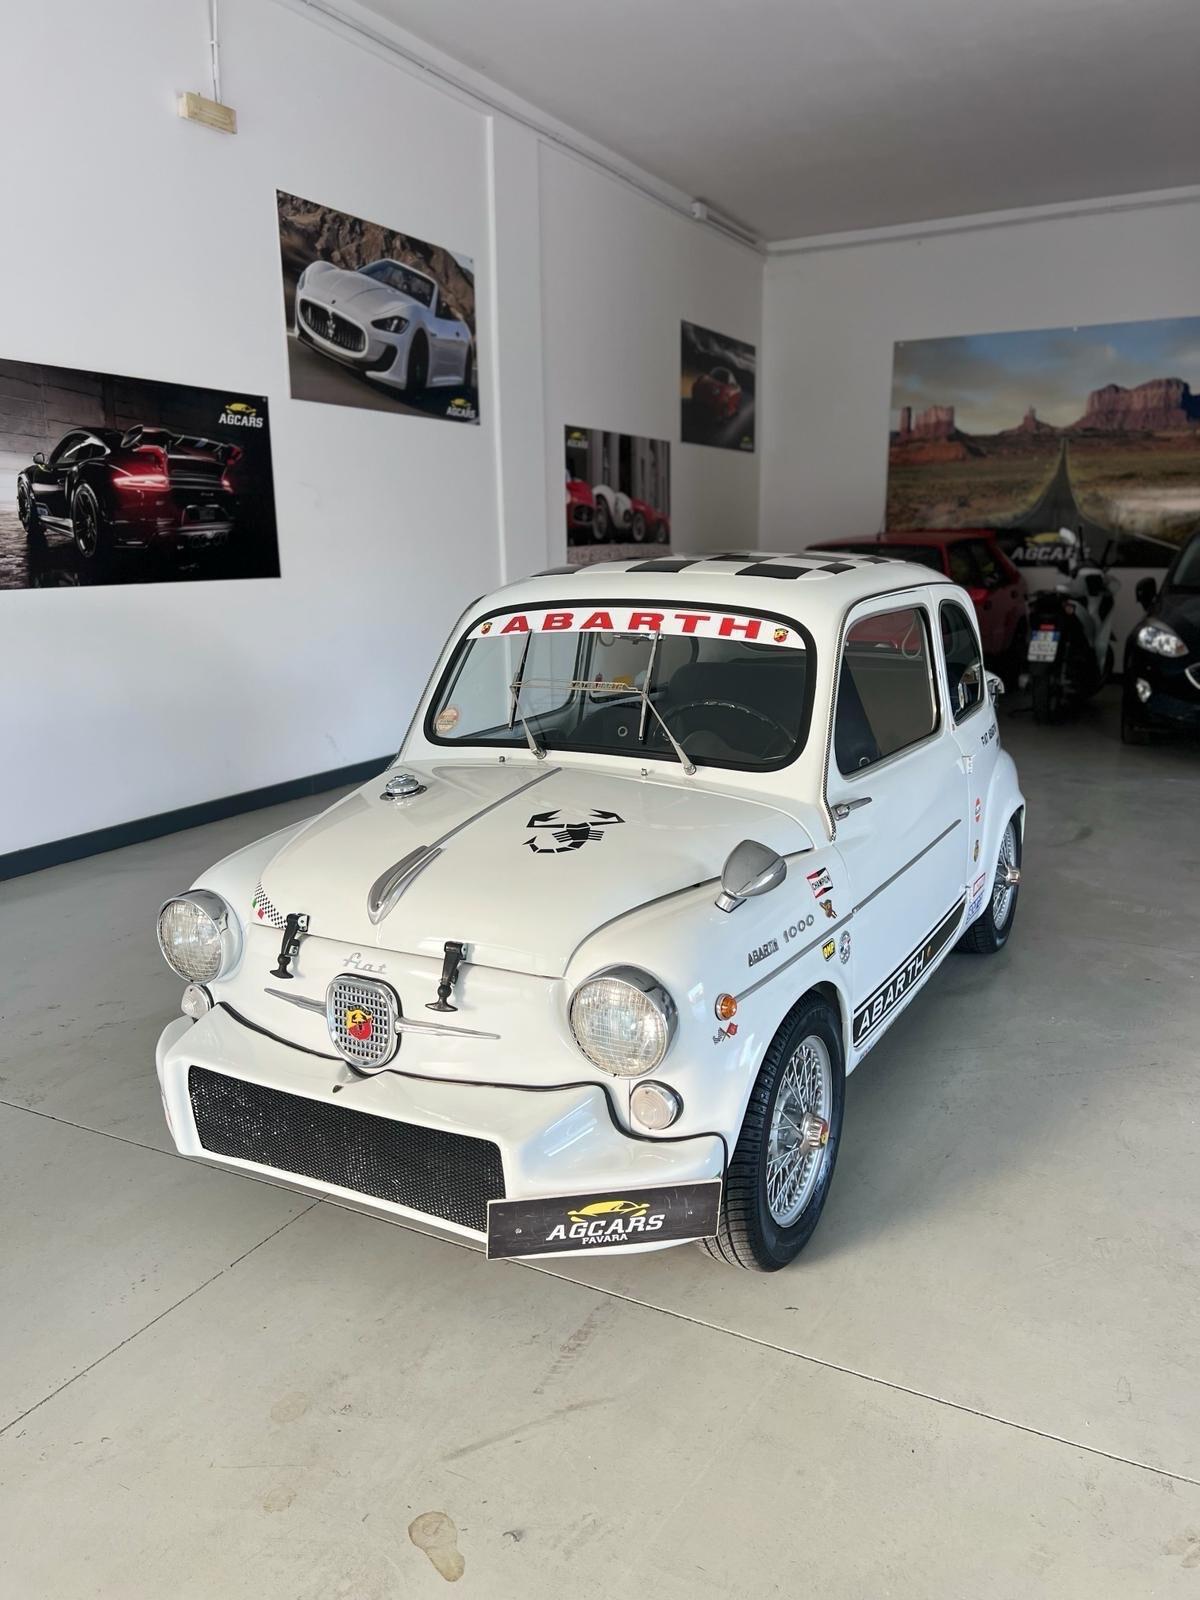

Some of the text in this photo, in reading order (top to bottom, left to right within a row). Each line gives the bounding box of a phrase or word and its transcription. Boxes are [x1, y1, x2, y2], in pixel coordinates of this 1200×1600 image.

[218, 412, 264, 428] AGCARS
[446, 405, 476, 419] AGCARS
[500, 611, 762, 640] ABARTH
[783, 914, 815, 943] 1000
[858, 950, 925, 1037] ABARTH
[546, 1214, 665, 1241] AGCARS
